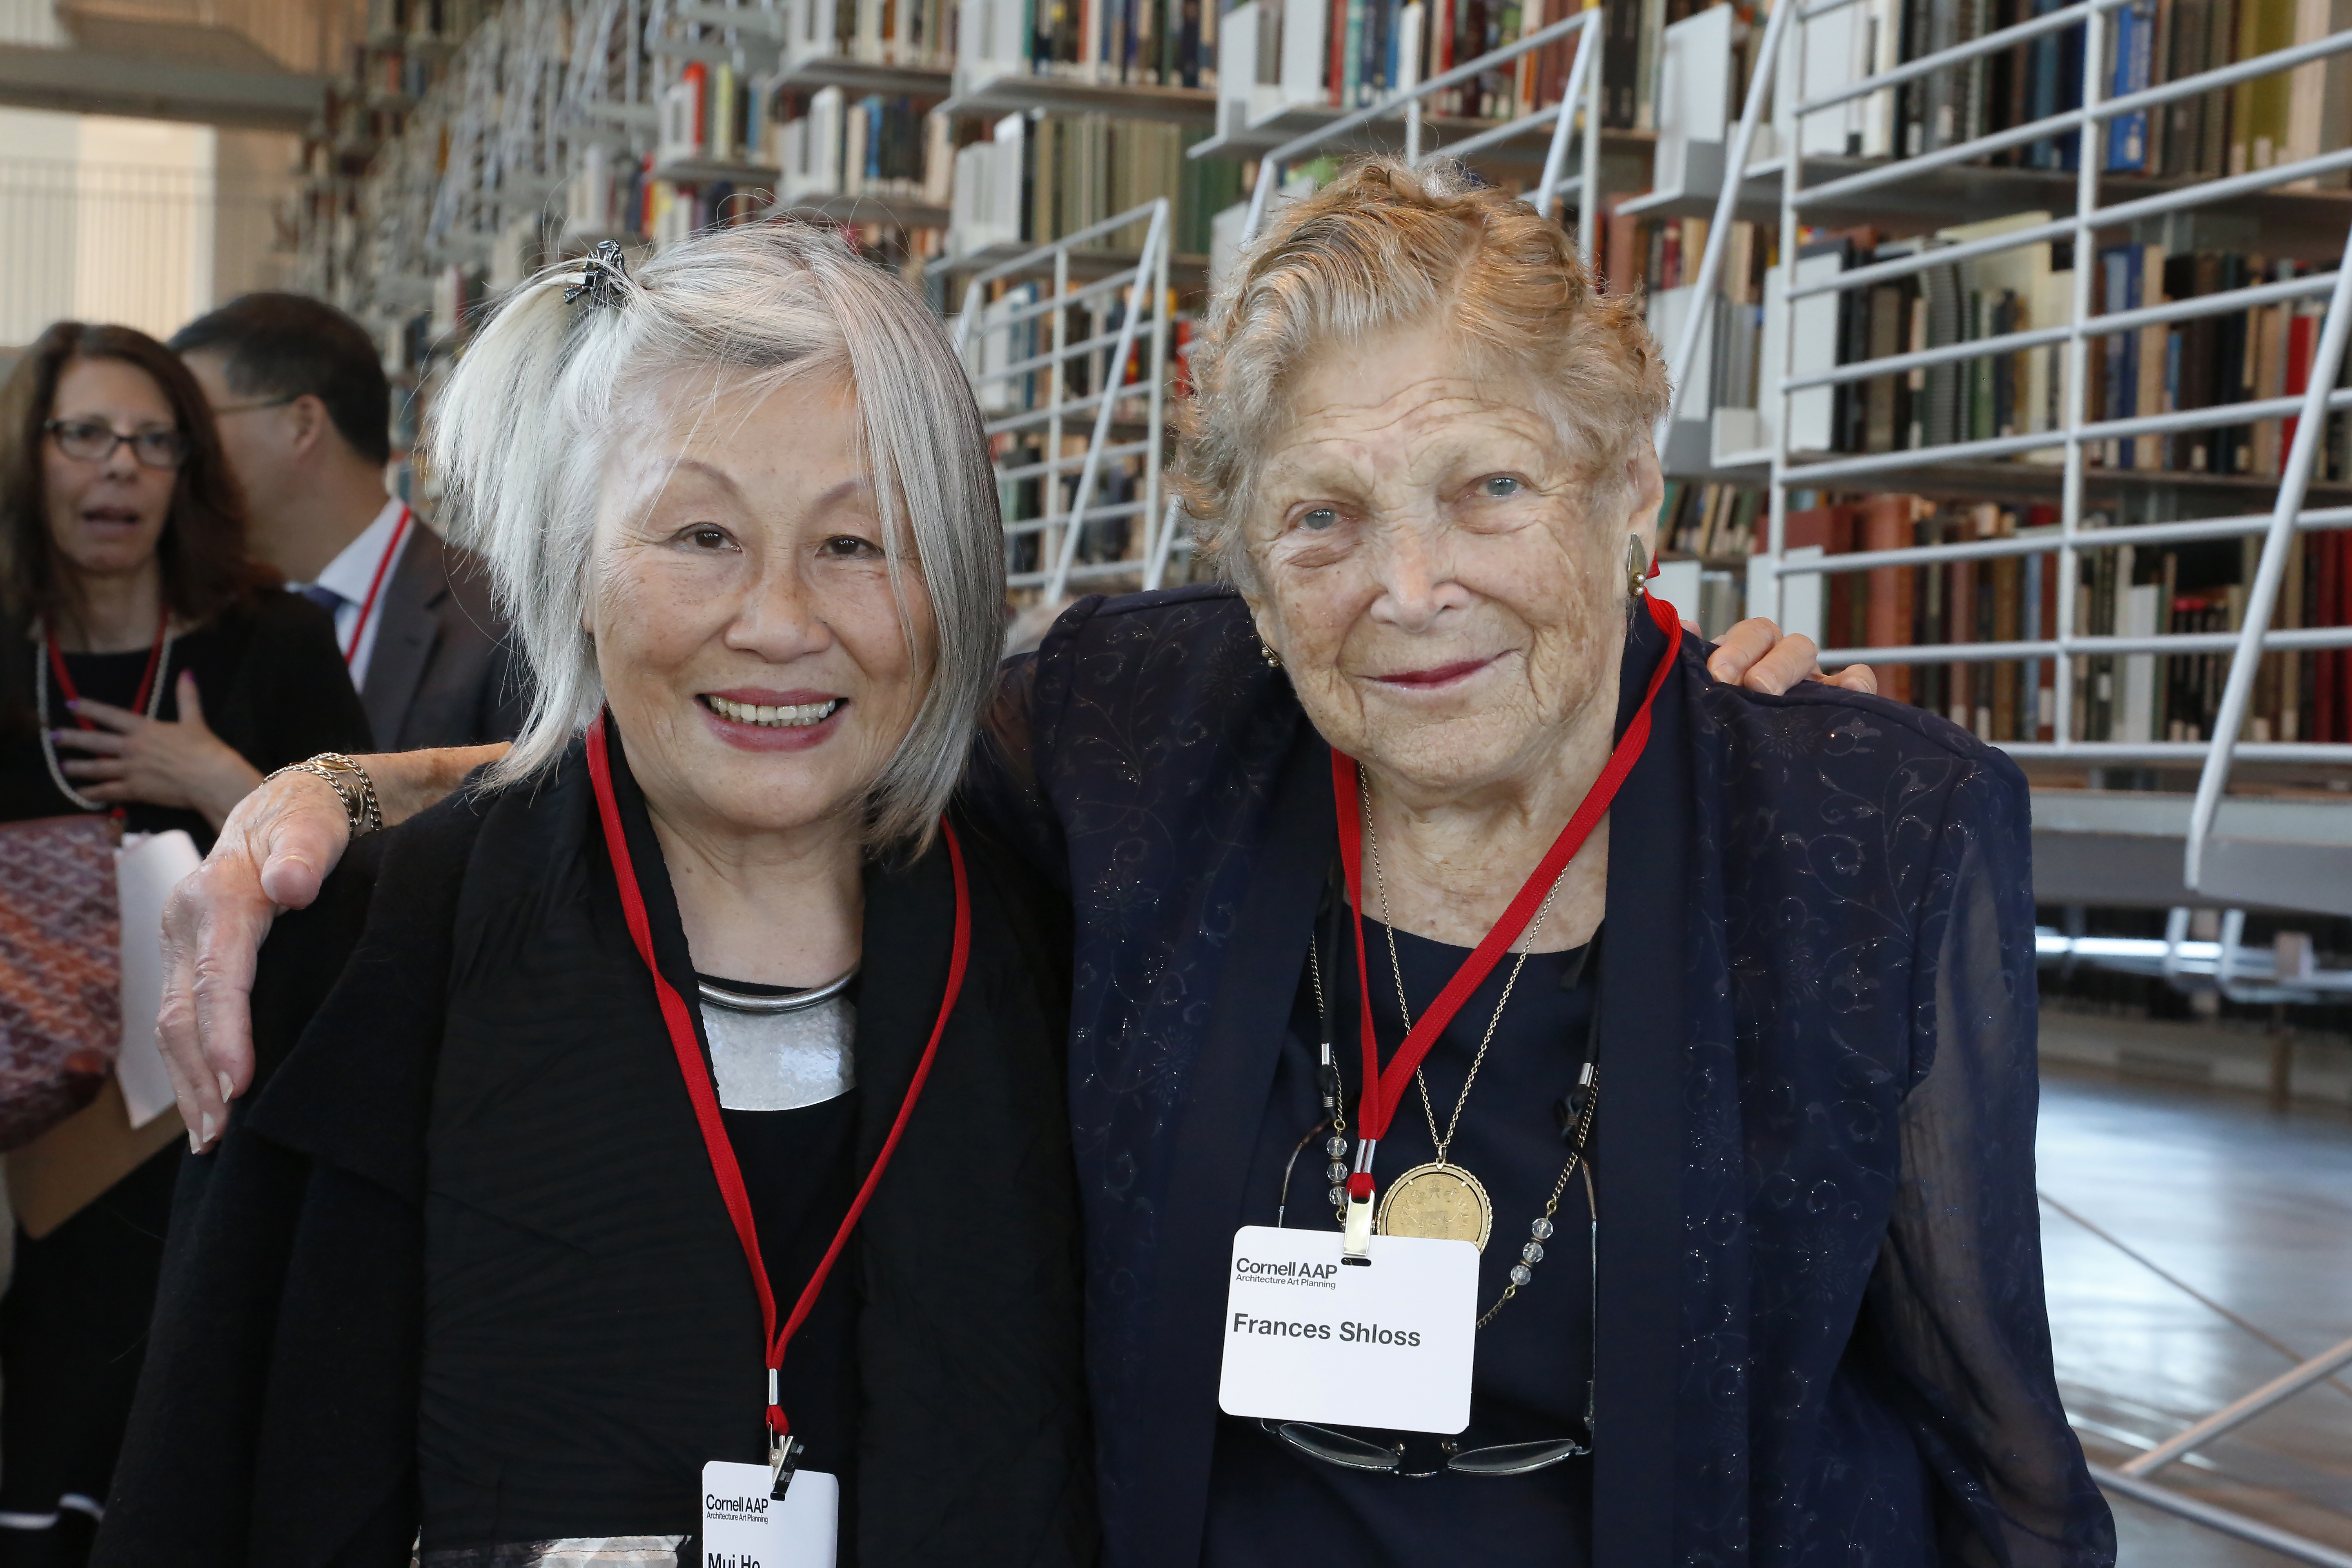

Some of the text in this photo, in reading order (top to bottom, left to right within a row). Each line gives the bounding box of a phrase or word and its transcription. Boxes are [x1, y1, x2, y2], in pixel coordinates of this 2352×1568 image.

[1236, 1258, 1337, 1279] Cornell AAP
[1236, 1274, 1286, 1285] Architecture
[1301, 1278, 1336, 1290] Planning
[1234, 1313, 1421, 1347] Frances Shloss
[706, 1494, 768, 1514] Cornell AAP
[706, 1511, 738, 1521] Architecture
[747, 1514, 768, 1525] Planning
[708, 1552, 760, 1568] Mui Ho
